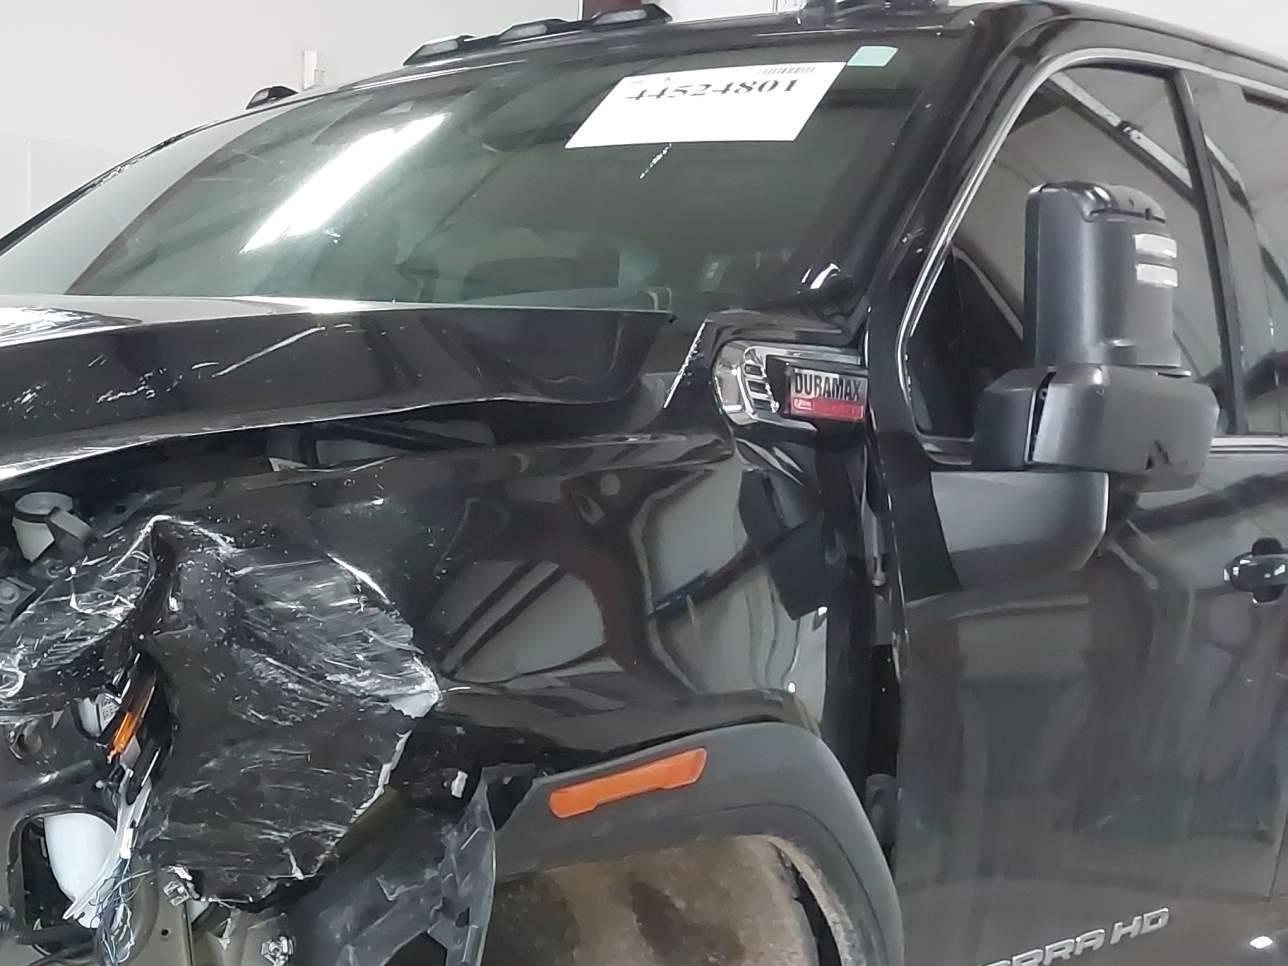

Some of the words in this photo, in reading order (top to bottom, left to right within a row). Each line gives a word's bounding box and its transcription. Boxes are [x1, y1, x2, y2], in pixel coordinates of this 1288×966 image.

[626, 79, 798, 101] 44524801
[794, 372, 861, 402] DURAMAX
[1110, 907, 1169, 945] HD
